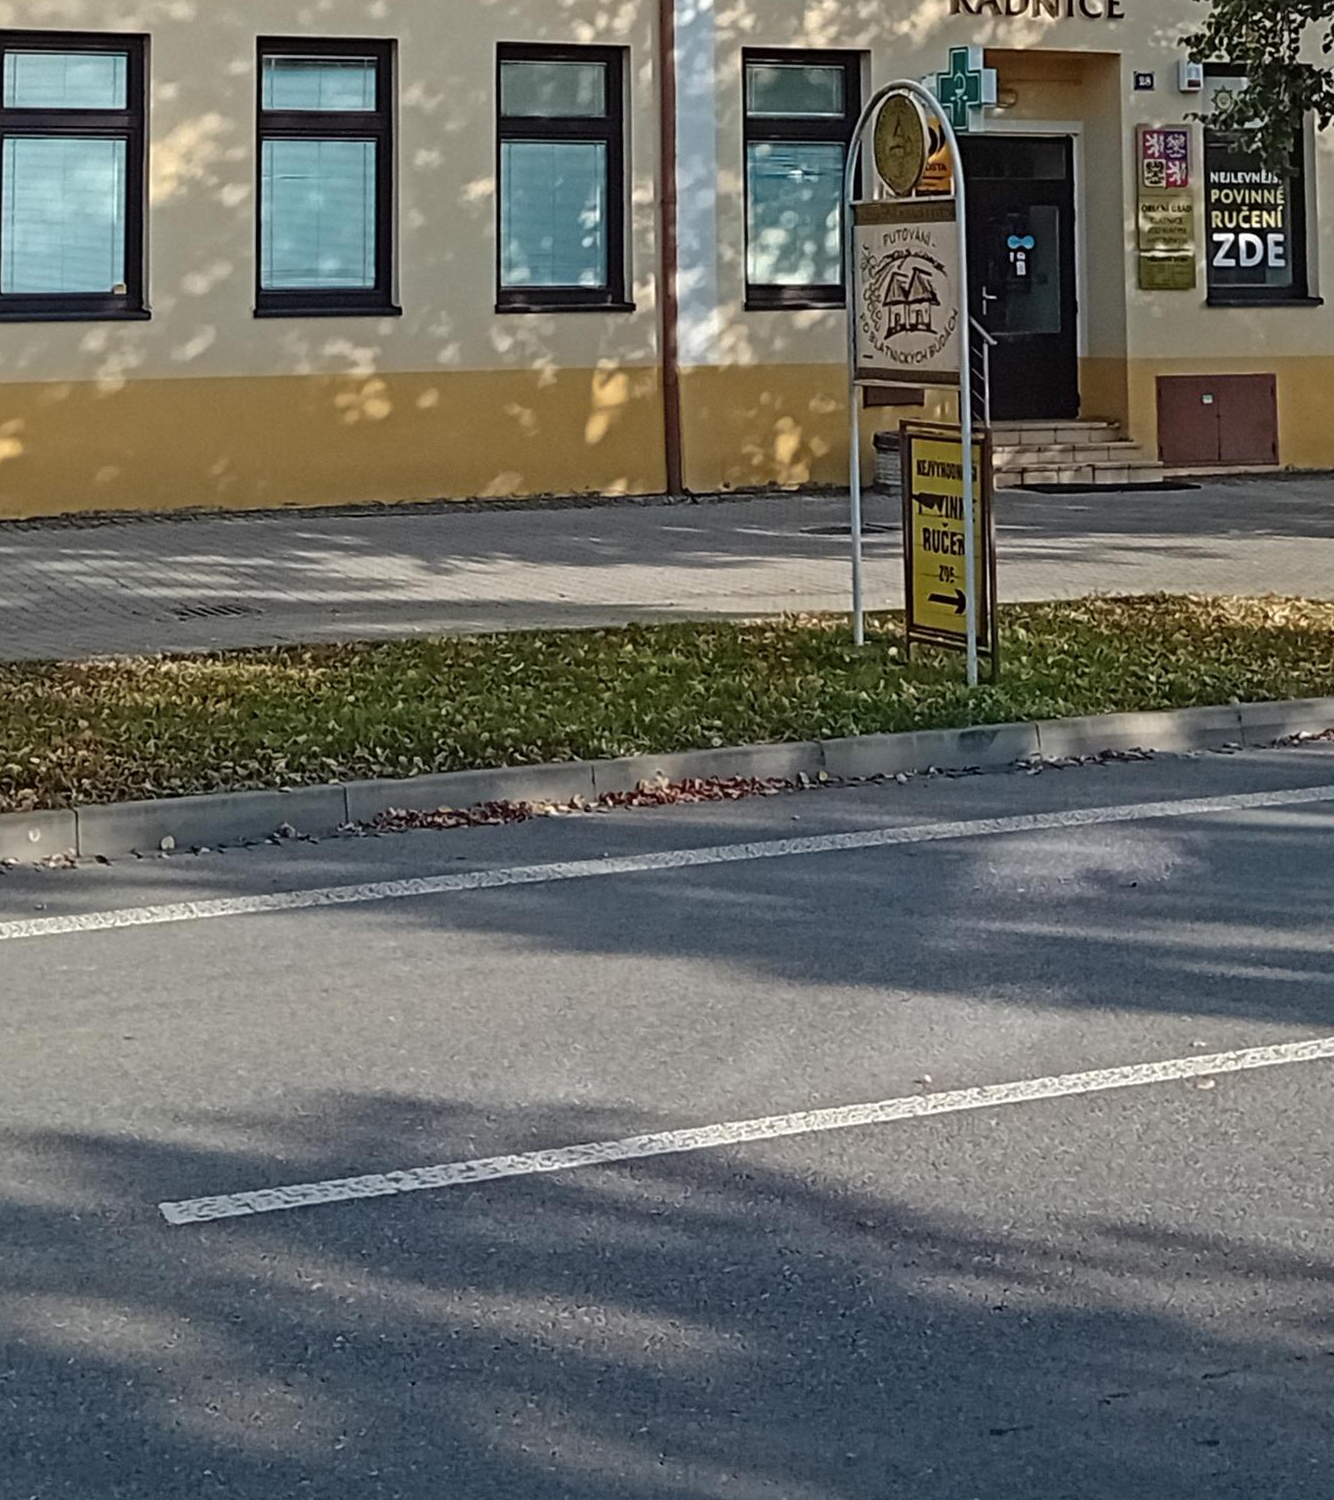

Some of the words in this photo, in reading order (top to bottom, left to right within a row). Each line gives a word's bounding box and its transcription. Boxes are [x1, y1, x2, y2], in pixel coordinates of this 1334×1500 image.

[1211, 185, 1285, 204] POVINNÉ
[1211, 205, 1283, 229] RUČENÍ
[1212, 232, 1286, 267] ZDE
[922, 522, 965, 556] RUČEN
